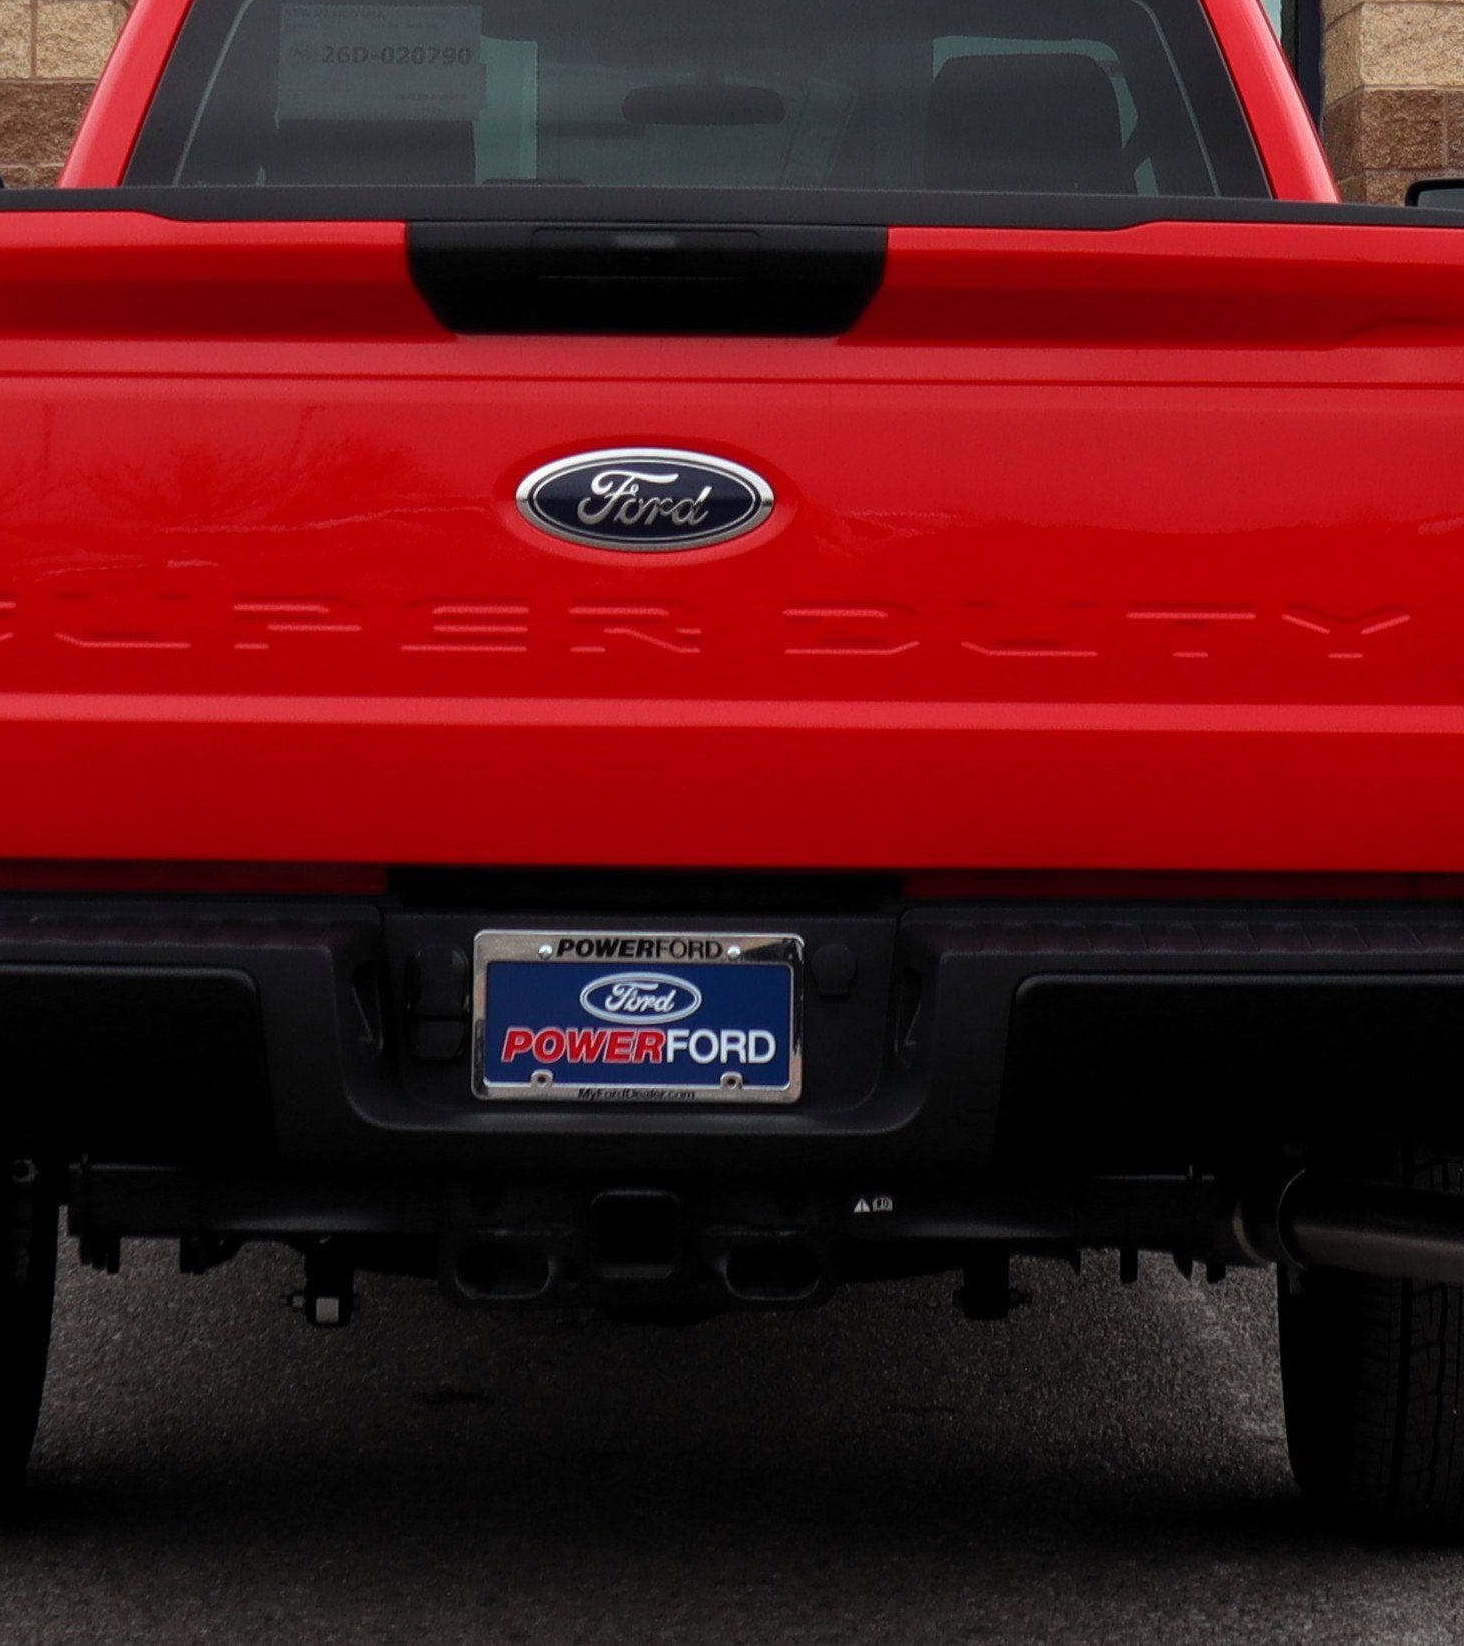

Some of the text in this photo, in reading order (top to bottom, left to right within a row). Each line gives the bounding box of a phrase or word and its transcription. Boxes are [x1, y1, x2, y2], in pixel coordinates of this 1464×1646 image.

[576, 469, 713, 525] Ford
[782, 600, 1411, 658] DUTY
[556, 938, 723, 960] POWERFORD
[604, 980, 677, 1014] Ford
[500, 1026, 777, 1064] POWERFORD
